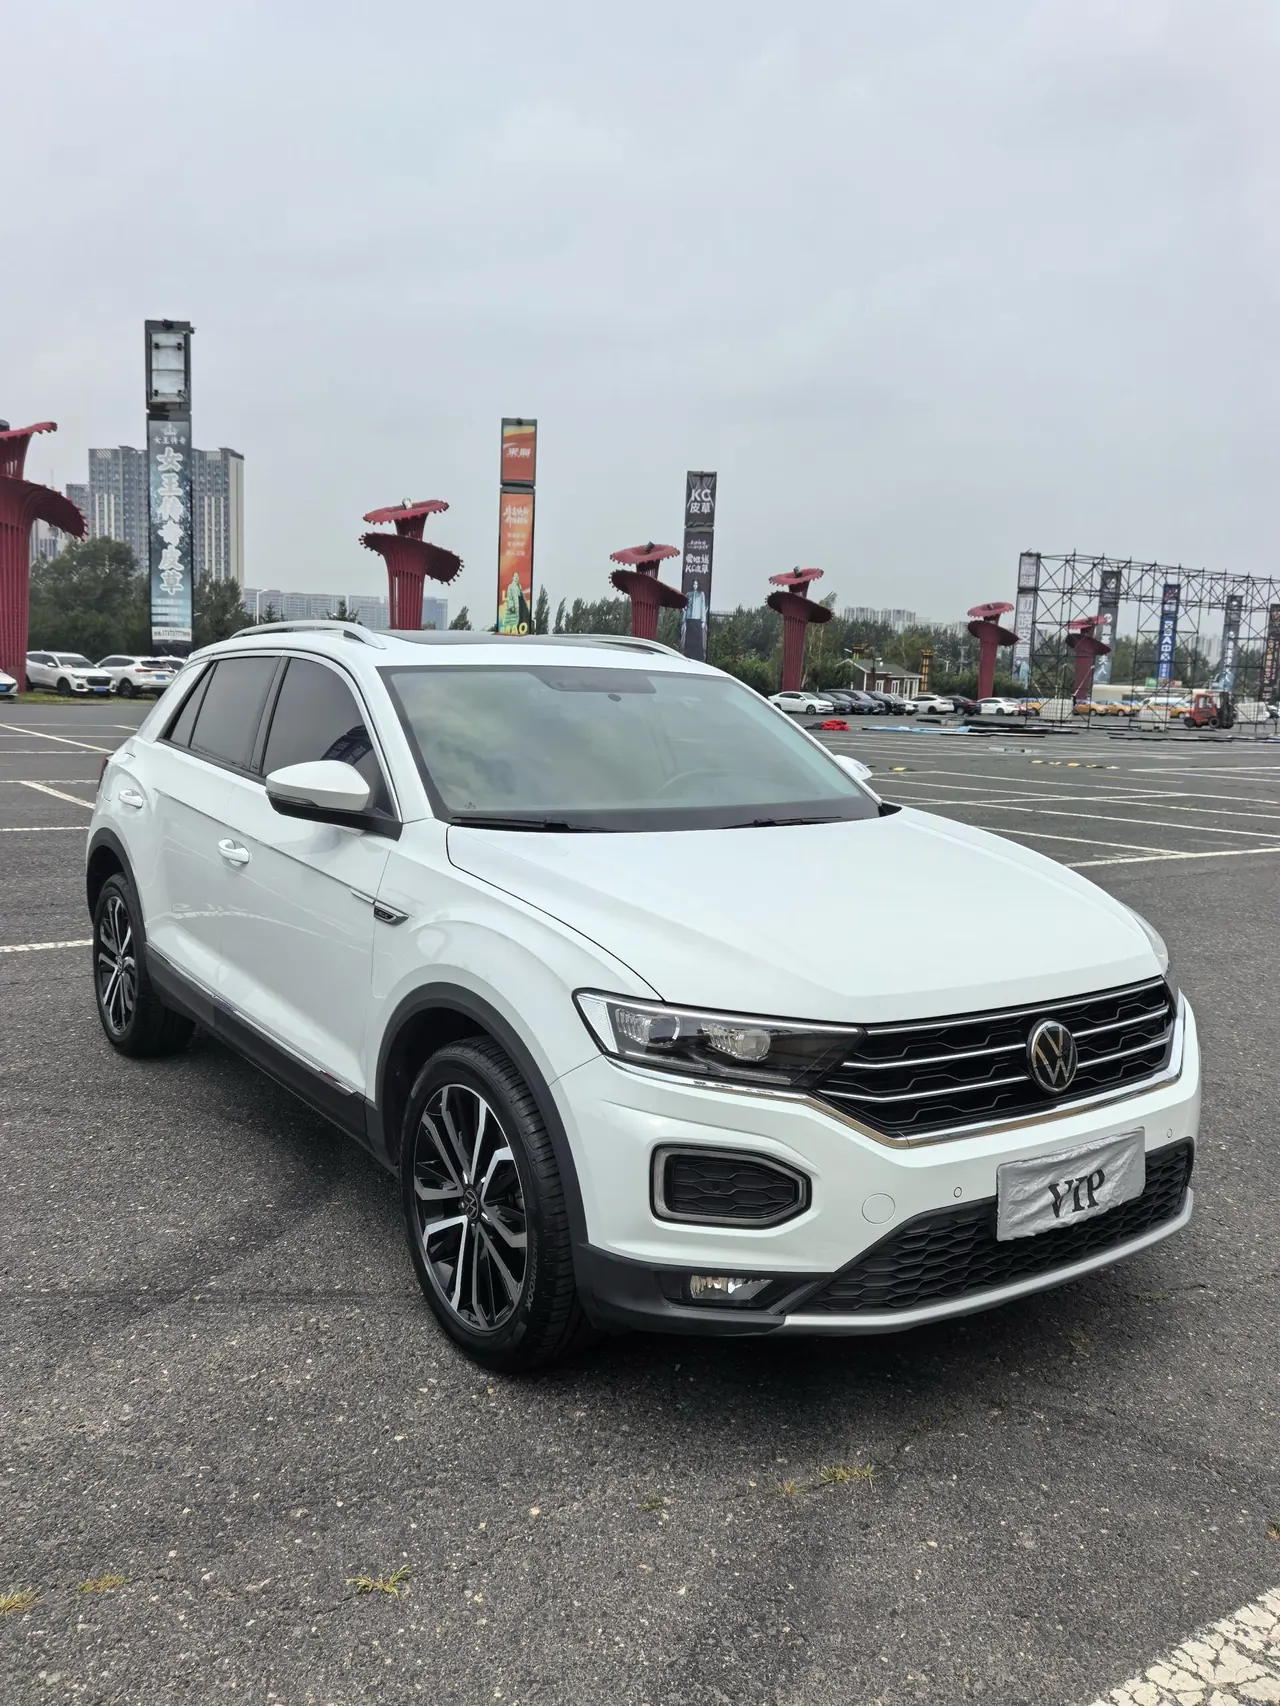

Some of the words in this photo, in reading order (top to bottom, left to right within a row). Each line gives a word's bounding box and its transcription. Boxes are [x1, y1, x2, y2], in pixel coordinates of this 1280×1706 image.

[691, 488, 712, 501] KC
[690, 502, 711, 514] 皮草
[1047, 1169, 1105, 1218] VIP
